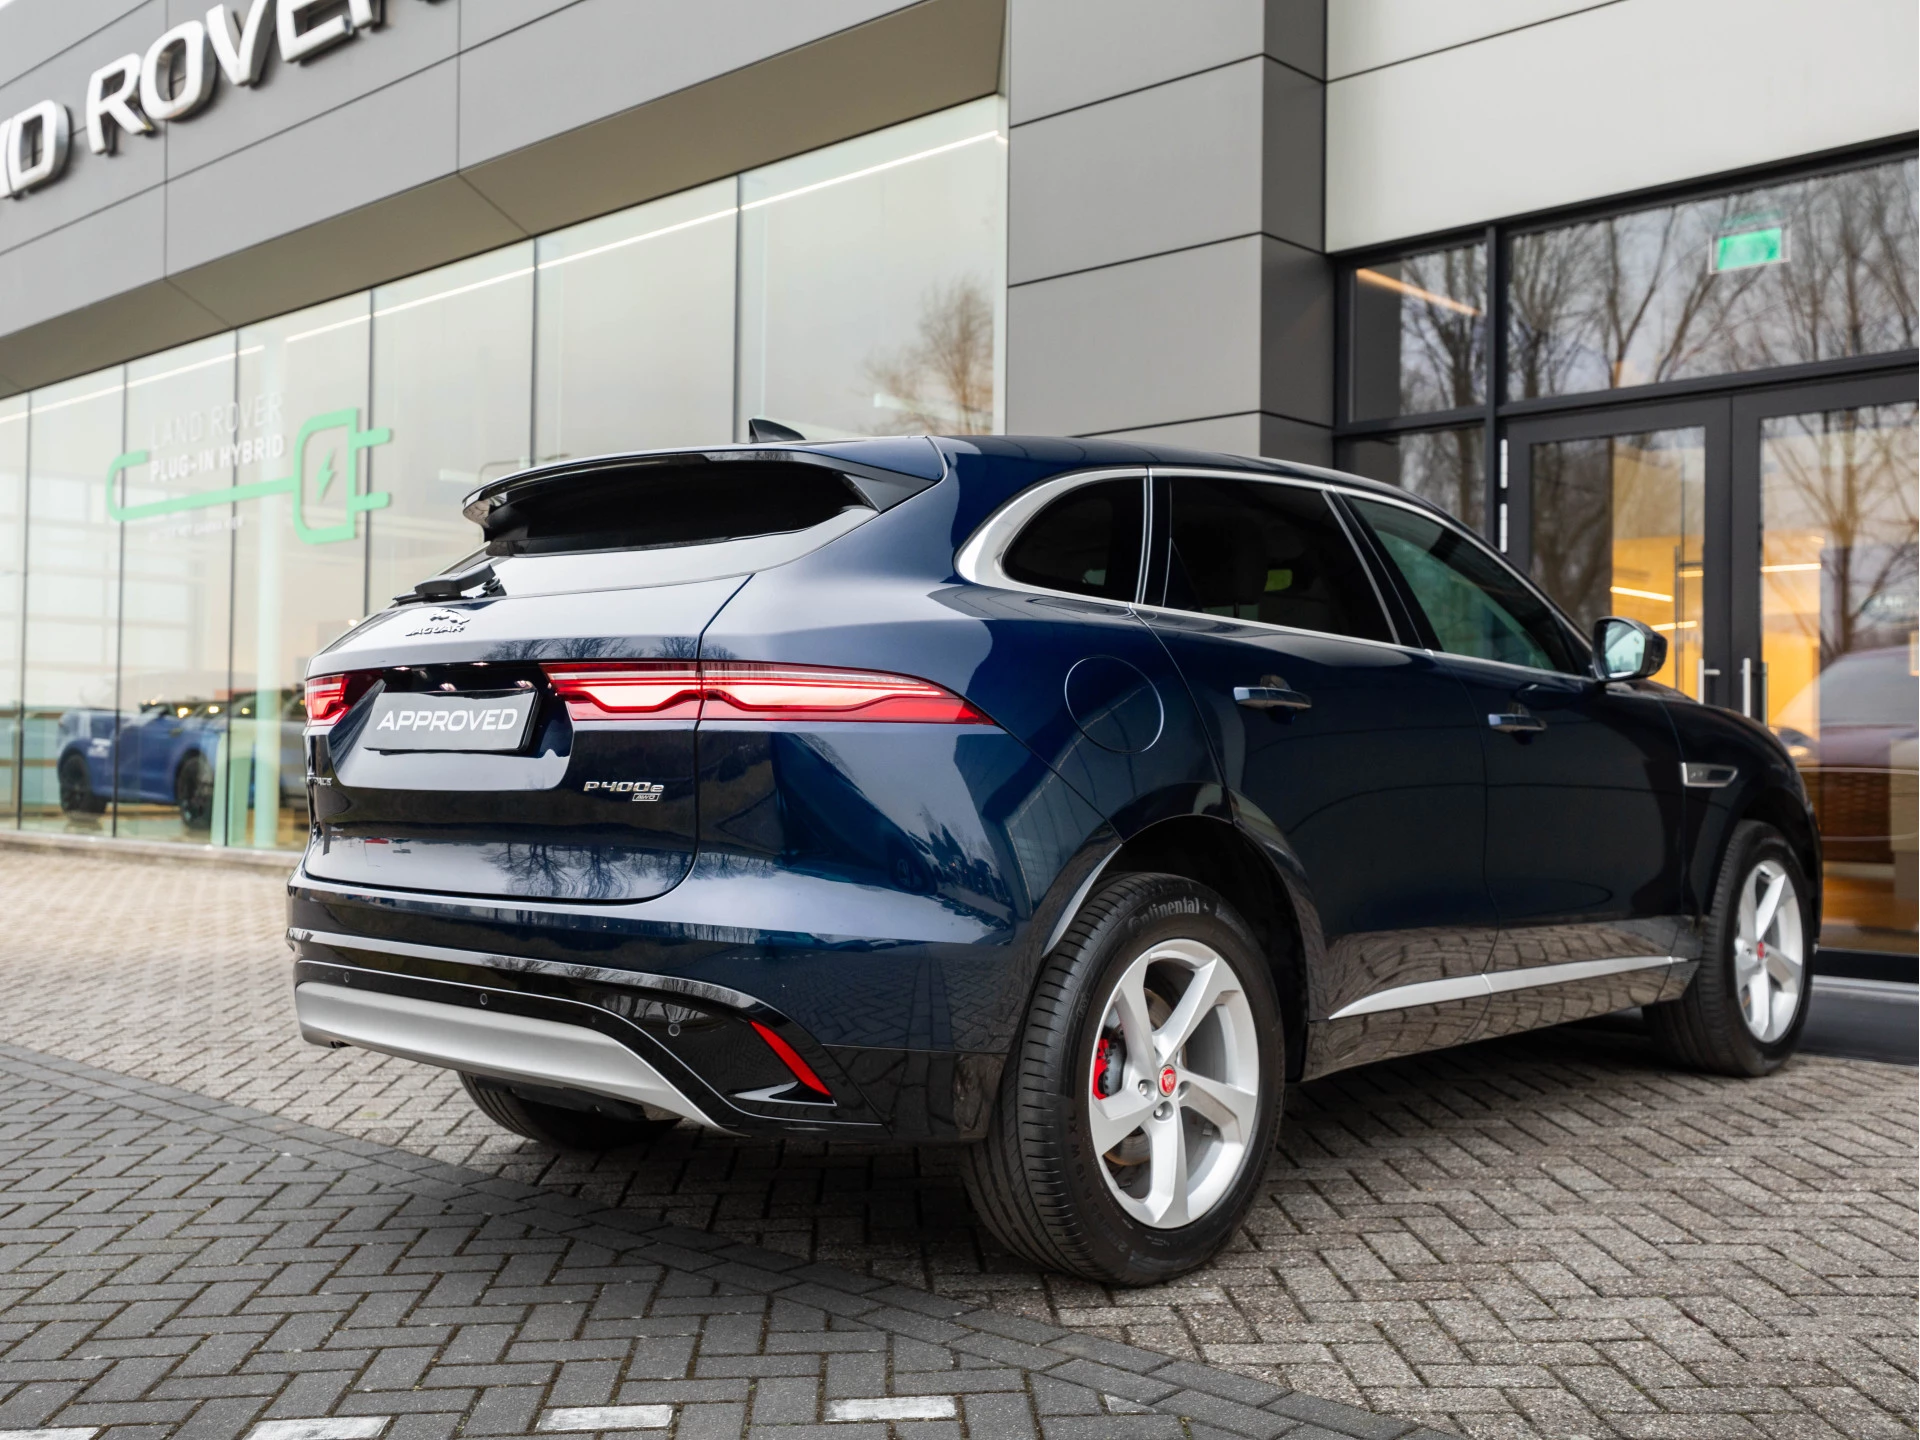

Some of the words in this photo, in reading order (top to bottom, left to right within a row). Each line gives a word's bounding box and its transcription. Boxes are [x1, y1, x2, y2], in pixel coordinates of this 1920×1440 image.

[0, 100, 68, 197] D
[86, 0, 376, 154] ROVE
[150, 410, 205, 451] LAND
[210, 391, 284, 438] ROVER
[150, 448, 215, 482] PLUG-IN
[219, 433, 285, 469] HYBRID
[405, 624, 466, 637] JAGUAR
[376, 708, 518, 731] APPROVED
[583, 781, 664, 793] P400e
[1126, 896, 1200, 932] Continental
